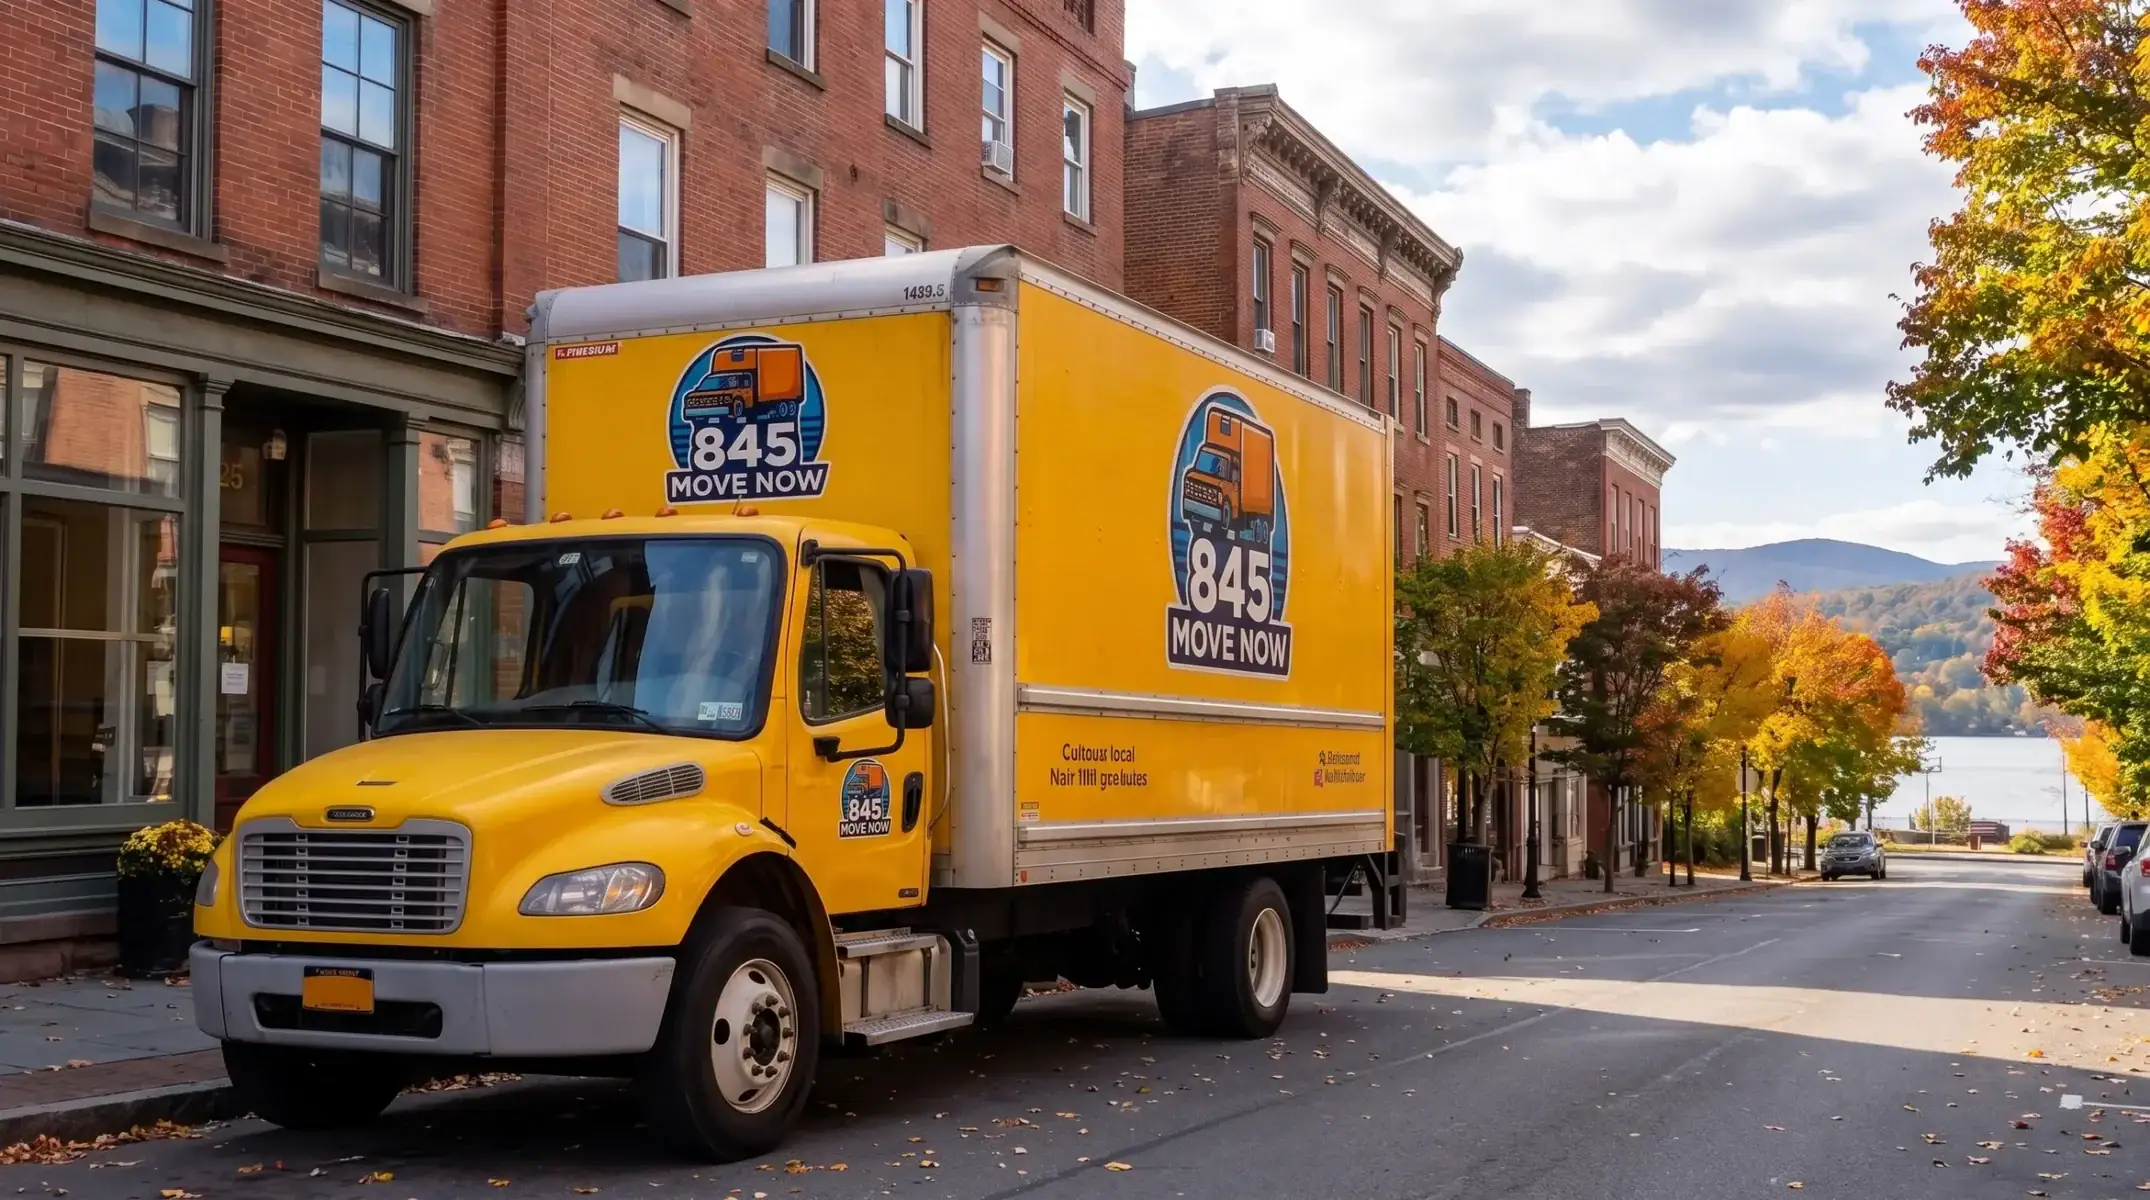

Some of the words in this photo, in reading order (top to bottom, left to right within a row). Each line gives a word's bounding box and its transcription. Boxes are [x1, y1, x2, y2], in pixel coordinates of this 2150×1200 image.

[694, 422, 796, 471] 845
[671, 473, 748, 498] MOVE
[756, 469, 823, 493] NOW
[1190, 538, 1270, 623] 845
[1173, 617, 1235, 661] MOVE
[1240, 628, 1287, 668] NOW
[1111, 744, 1135, 762] local
[1050, 768, 1075, 786] Nair
[849, 798, 882, 821] 845
[841, 822, 866, 835] MOVE
[868, 821, 889, 833] NOW
